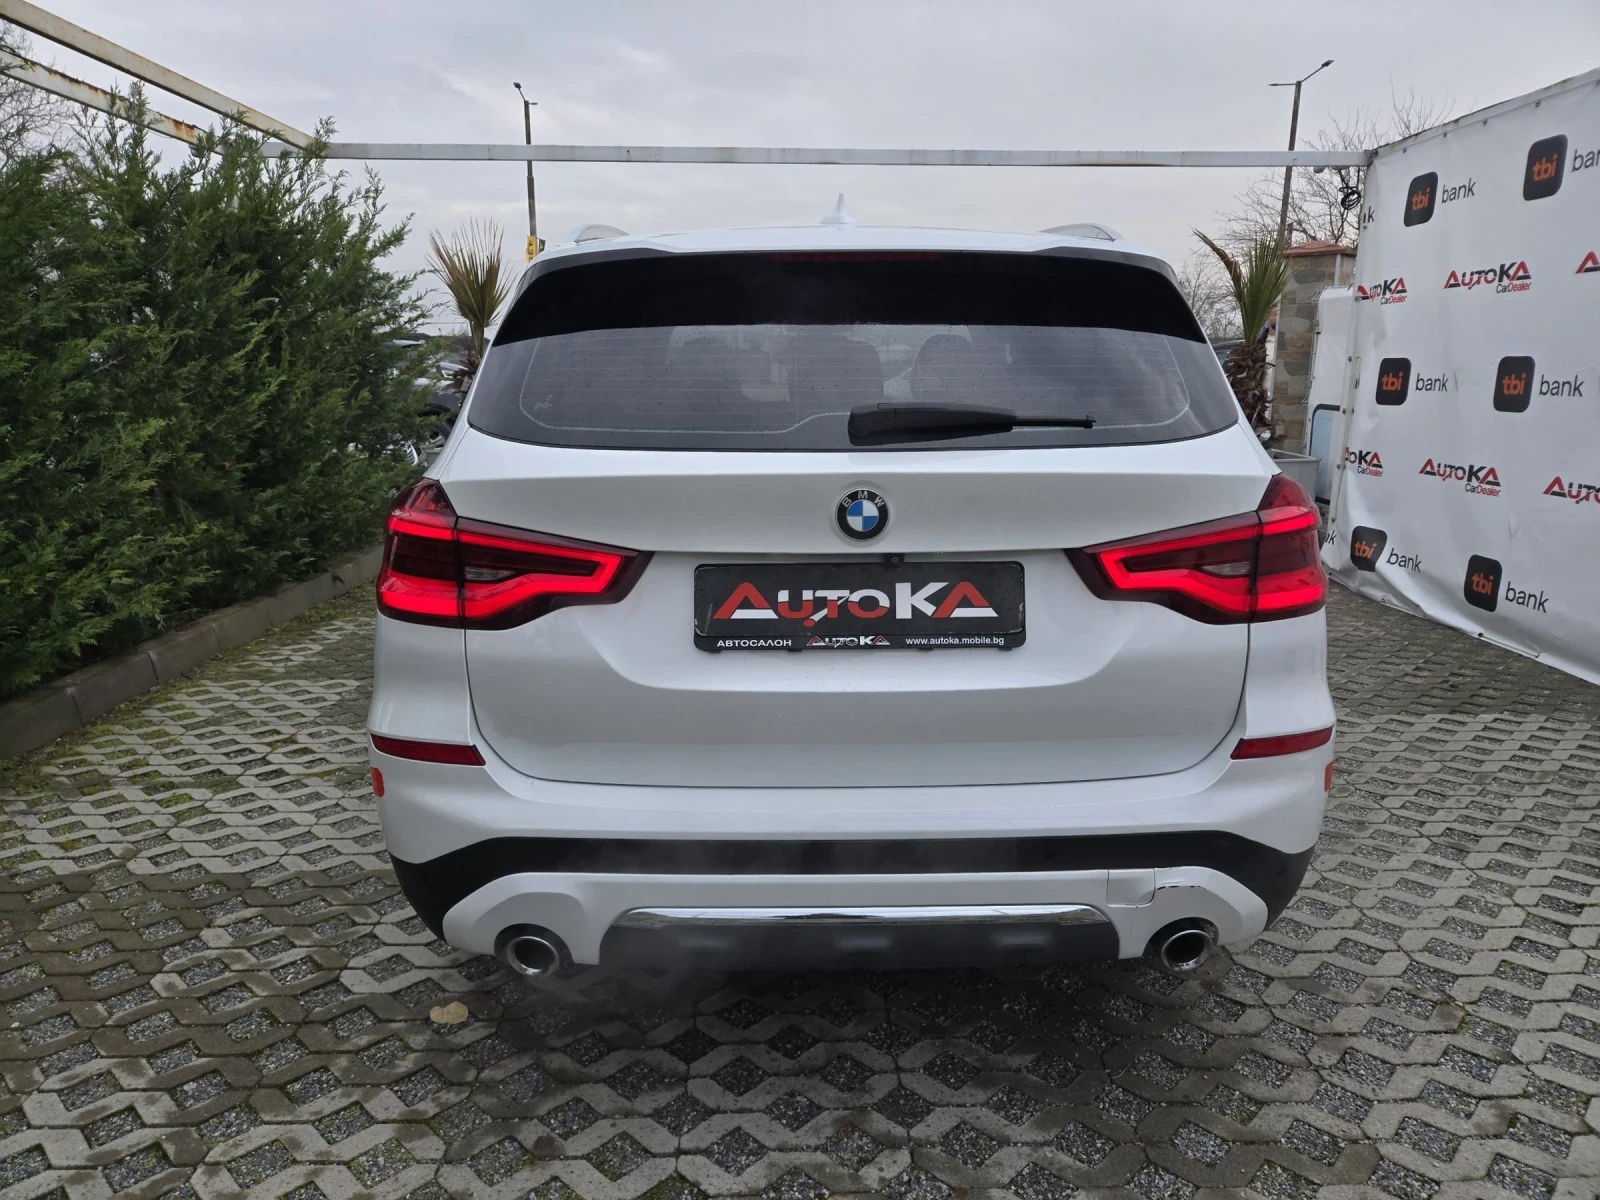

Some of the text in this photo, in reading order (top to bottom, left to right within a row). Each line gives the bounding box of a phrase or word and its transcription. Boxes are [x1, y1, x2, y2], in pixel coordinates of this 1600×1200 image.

[1532, 149, 1600, 182] tbi ba
[1411, 178, 1477, 211] tbi bank
[1382, 372, 1449, 392] tbi bank
[1502, 373, 1585, 397] tbi bank
[842, 490, 885, 508] BMW
[1354, 541, 1422, 573] tbi bank
[1472, 572, 1549, 613] tbi bank
[717, 639, 792, 647] АВТОСАЛОН
[905, 636, 1005, 646] www.autoka.mobile.bg
